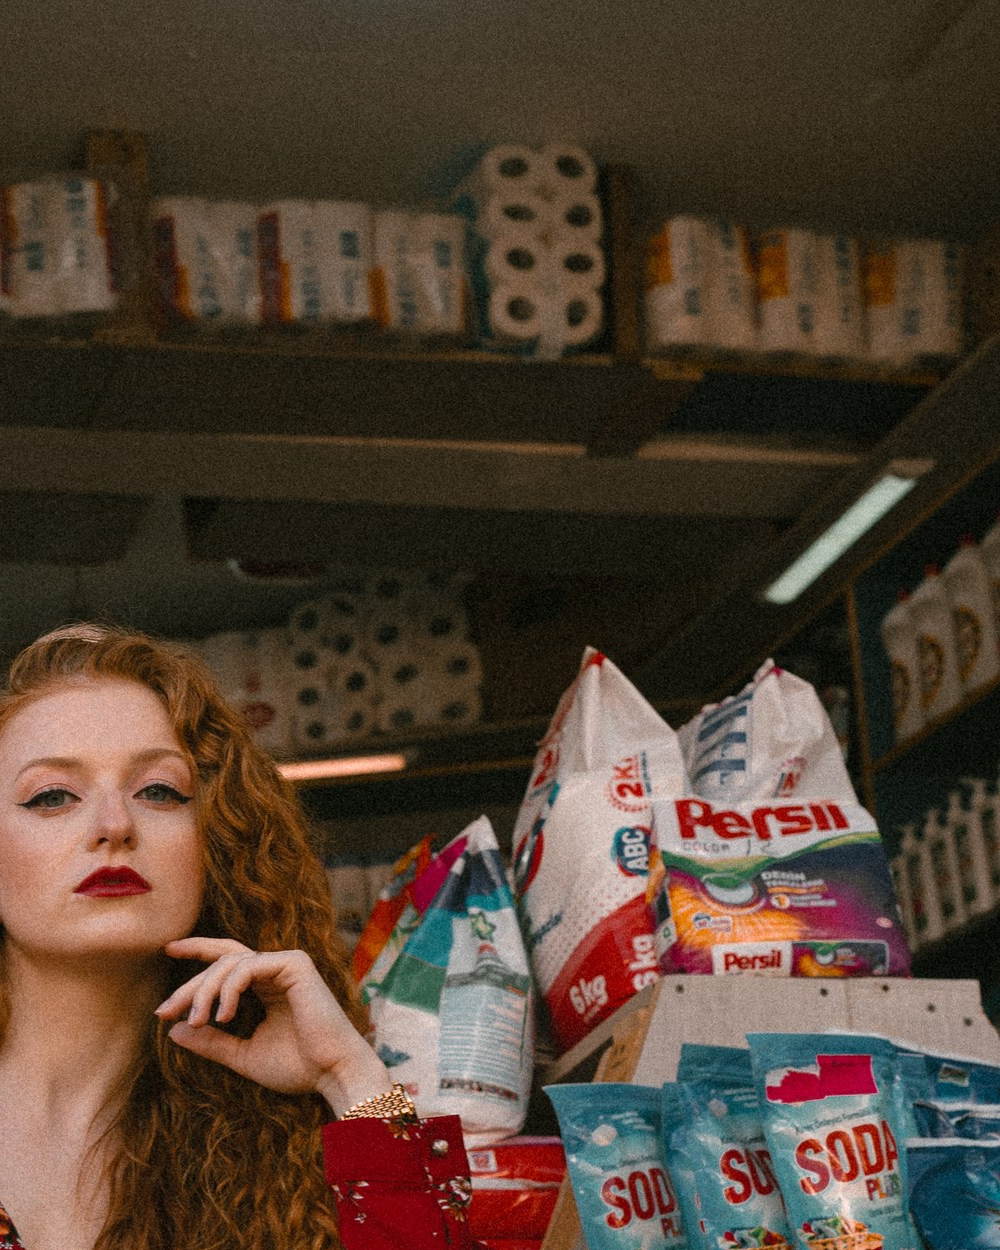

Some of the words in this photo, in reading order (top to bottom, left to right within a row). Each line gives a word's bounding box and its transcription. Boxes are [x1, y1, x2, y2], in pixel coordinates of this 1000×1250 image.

[675, 799, 850, 841] Persil
[621, 829, 649, 871] ABC
[724, 951, 782, 972] Persil
[568, 974, 609, 1015] 6kg
[795, 1120, 899, 1196] SODA
